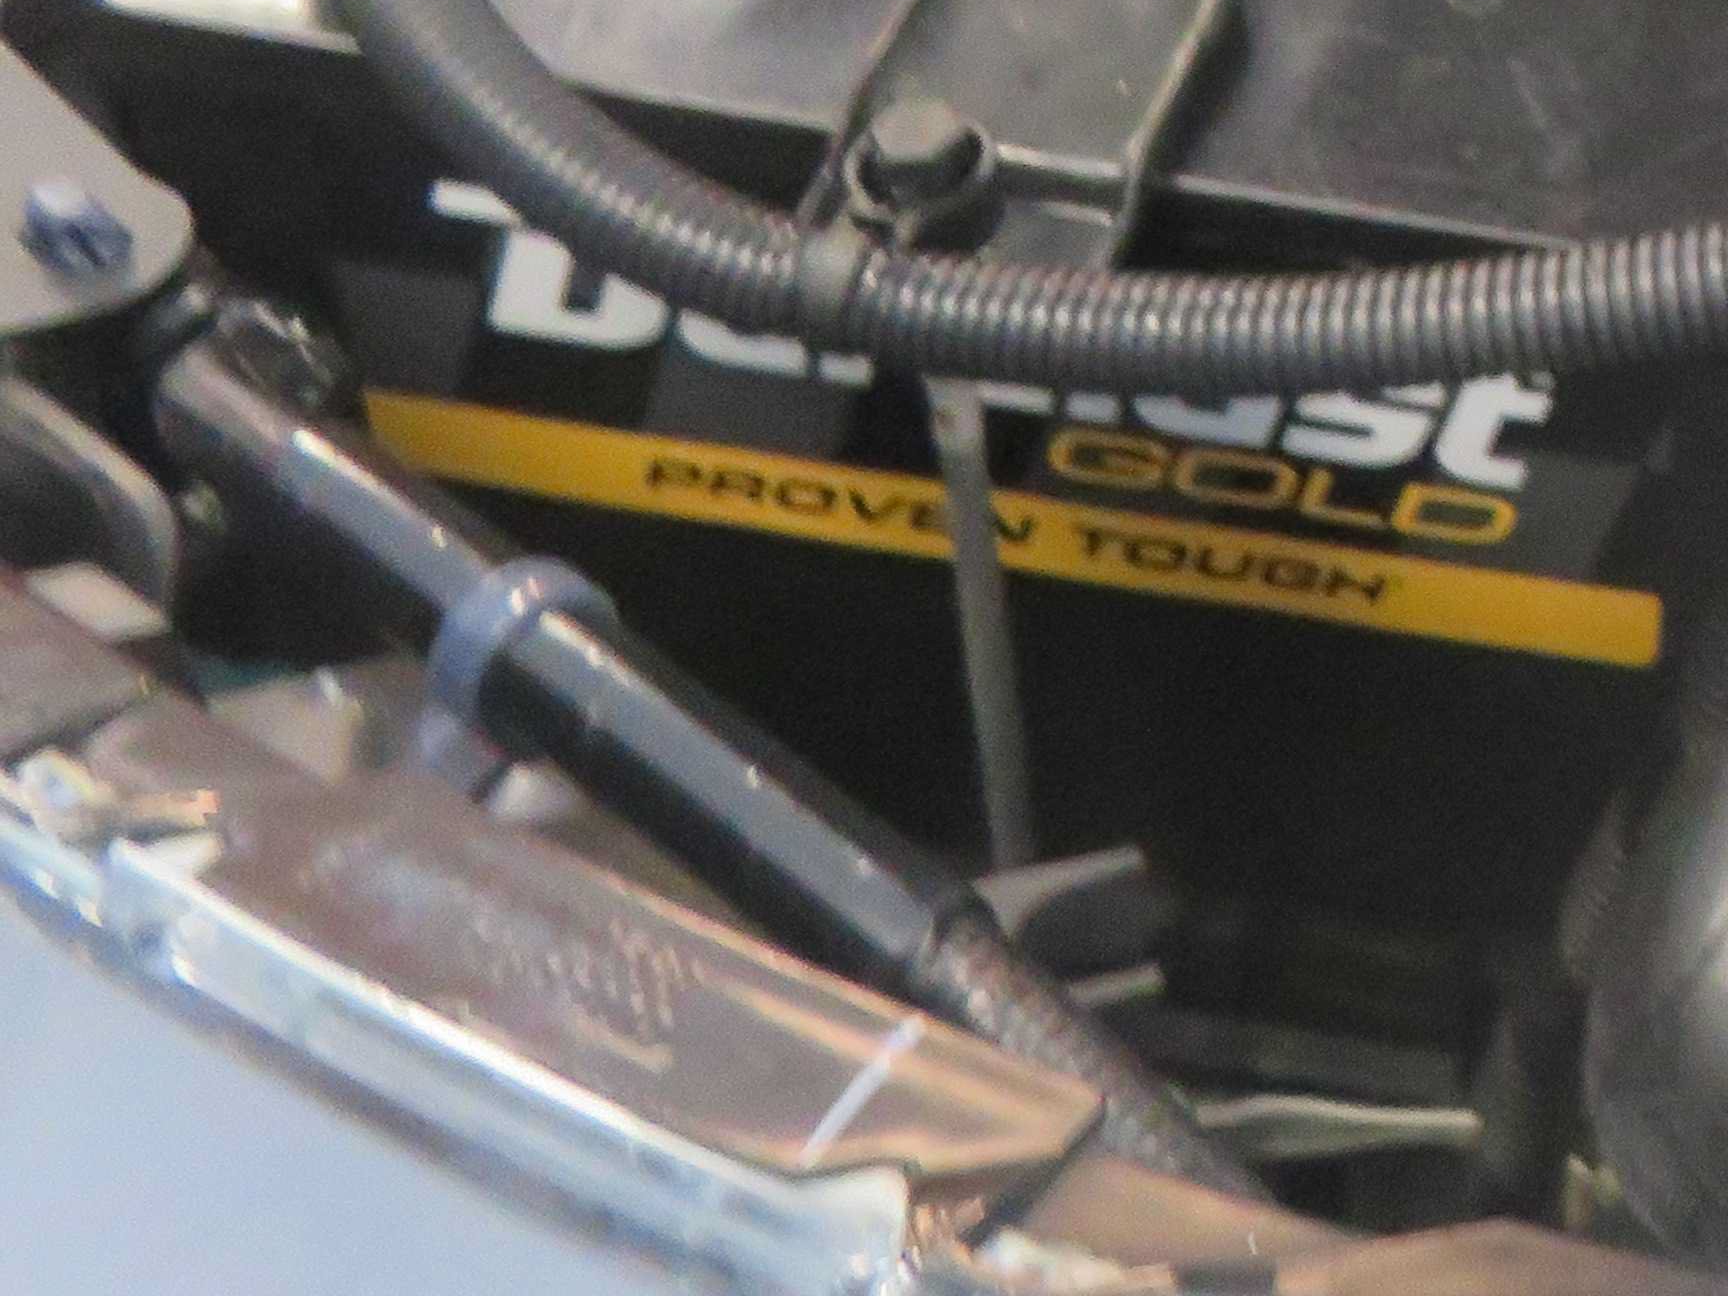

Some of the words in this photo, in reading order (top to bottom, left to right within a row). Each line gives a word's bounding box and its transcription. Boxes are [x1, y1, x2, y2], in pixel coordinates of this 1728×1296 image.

[644, 454, 1035, 544] PROVEN
[1072, 520, 1390, 605] TOUGH
[1046, 426, 1518, 546] GOLD
